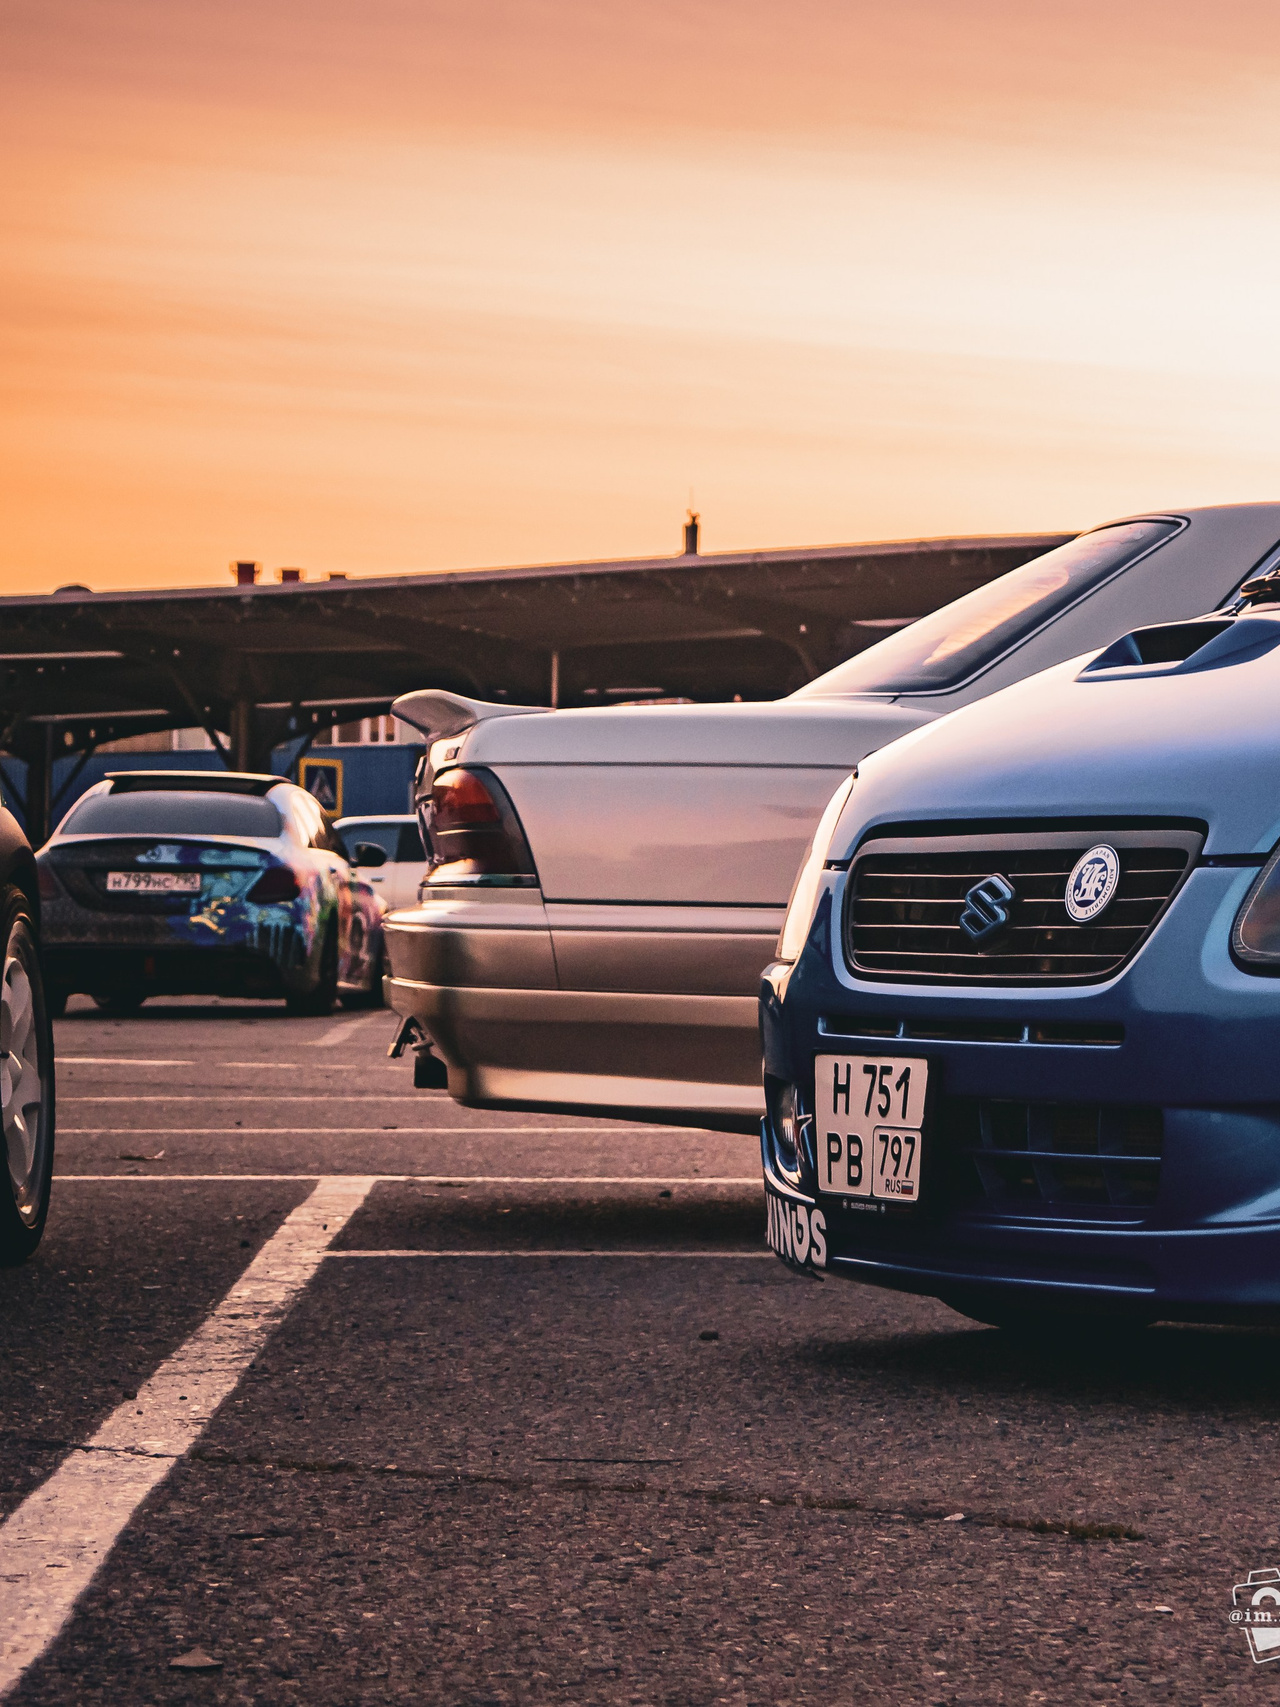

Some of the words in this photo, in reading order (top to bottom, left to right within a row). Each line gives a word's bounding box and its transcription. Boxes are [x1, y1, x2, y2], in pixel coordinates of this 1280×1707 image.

[863, 1064, 911, 1119] 751
[879, 1134, 916, 1178] 797
[885, 1179, 901, 1193] RUS
